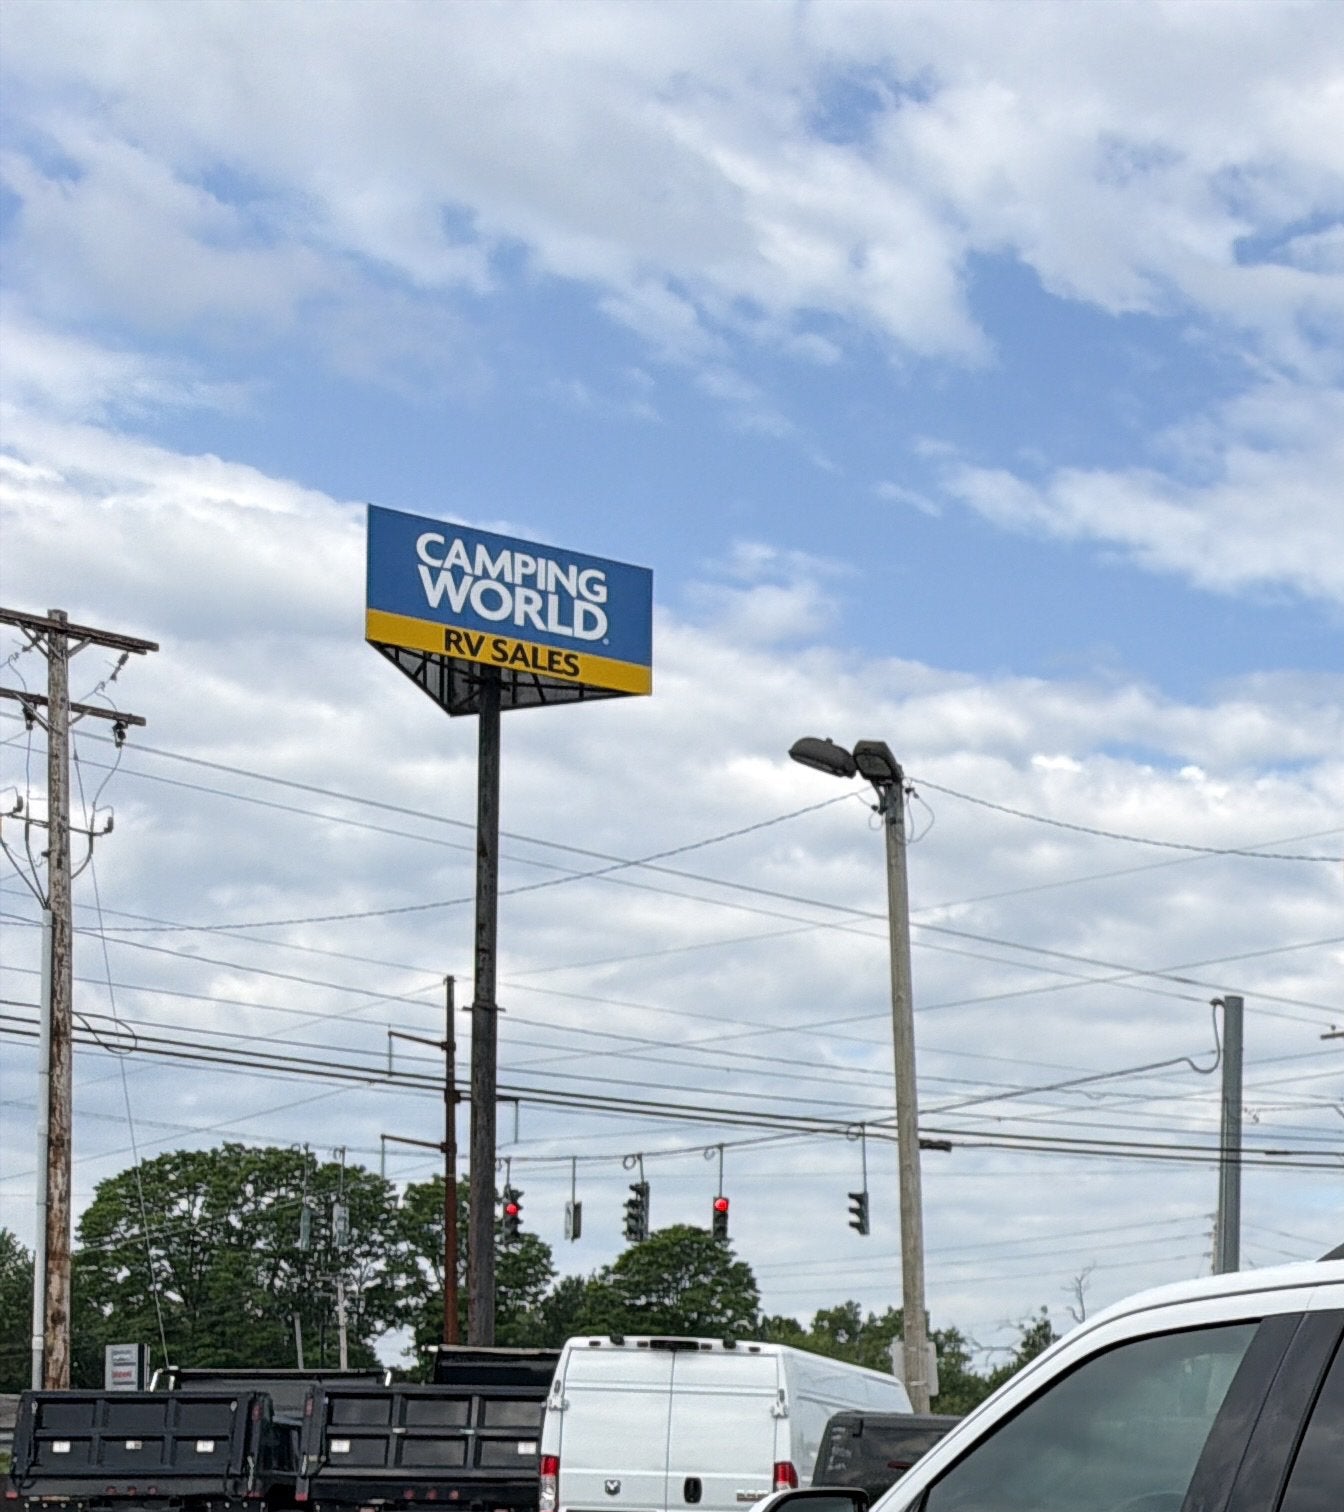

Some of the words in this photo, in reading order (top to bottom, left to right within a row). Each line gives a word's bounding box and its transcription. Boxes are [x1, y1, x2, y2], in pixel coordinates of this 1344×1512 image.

[416, 532, 608, 604] CAMPING
[417, 563, 609, 642] WORLD
[444, 628, 486, 657] RV
[491, 639, 581, 678] SALES
